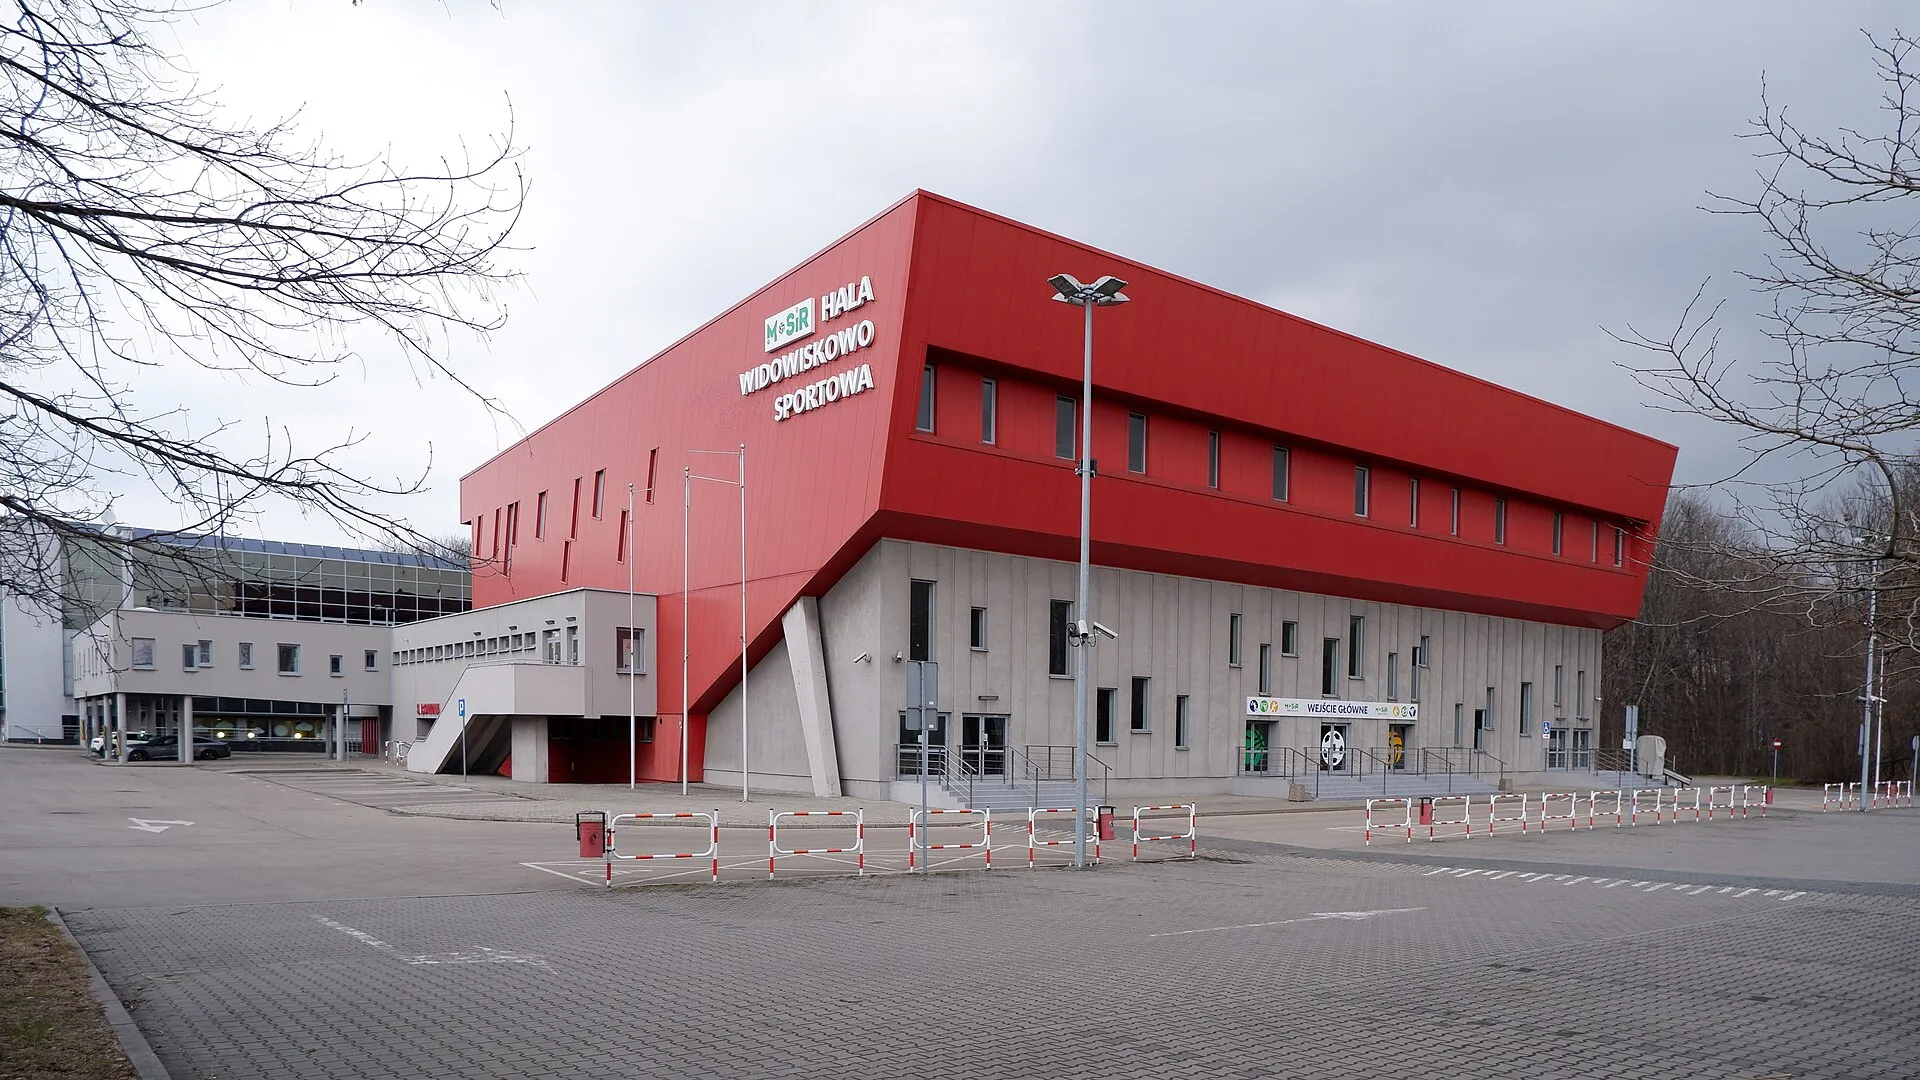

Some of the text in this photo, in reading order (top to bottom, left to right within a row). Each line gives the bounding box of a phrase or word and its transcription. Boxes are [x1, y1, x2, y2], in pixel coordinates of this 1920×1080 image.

[821, 275, 875, 322] HALA
[739, 319, 875, 396] WIDOWISKOWO
[774, 363, 875, 421] SPORTOWA
[1307, 702, 1369, 715] WEJŚCIE GŁÓWNE
